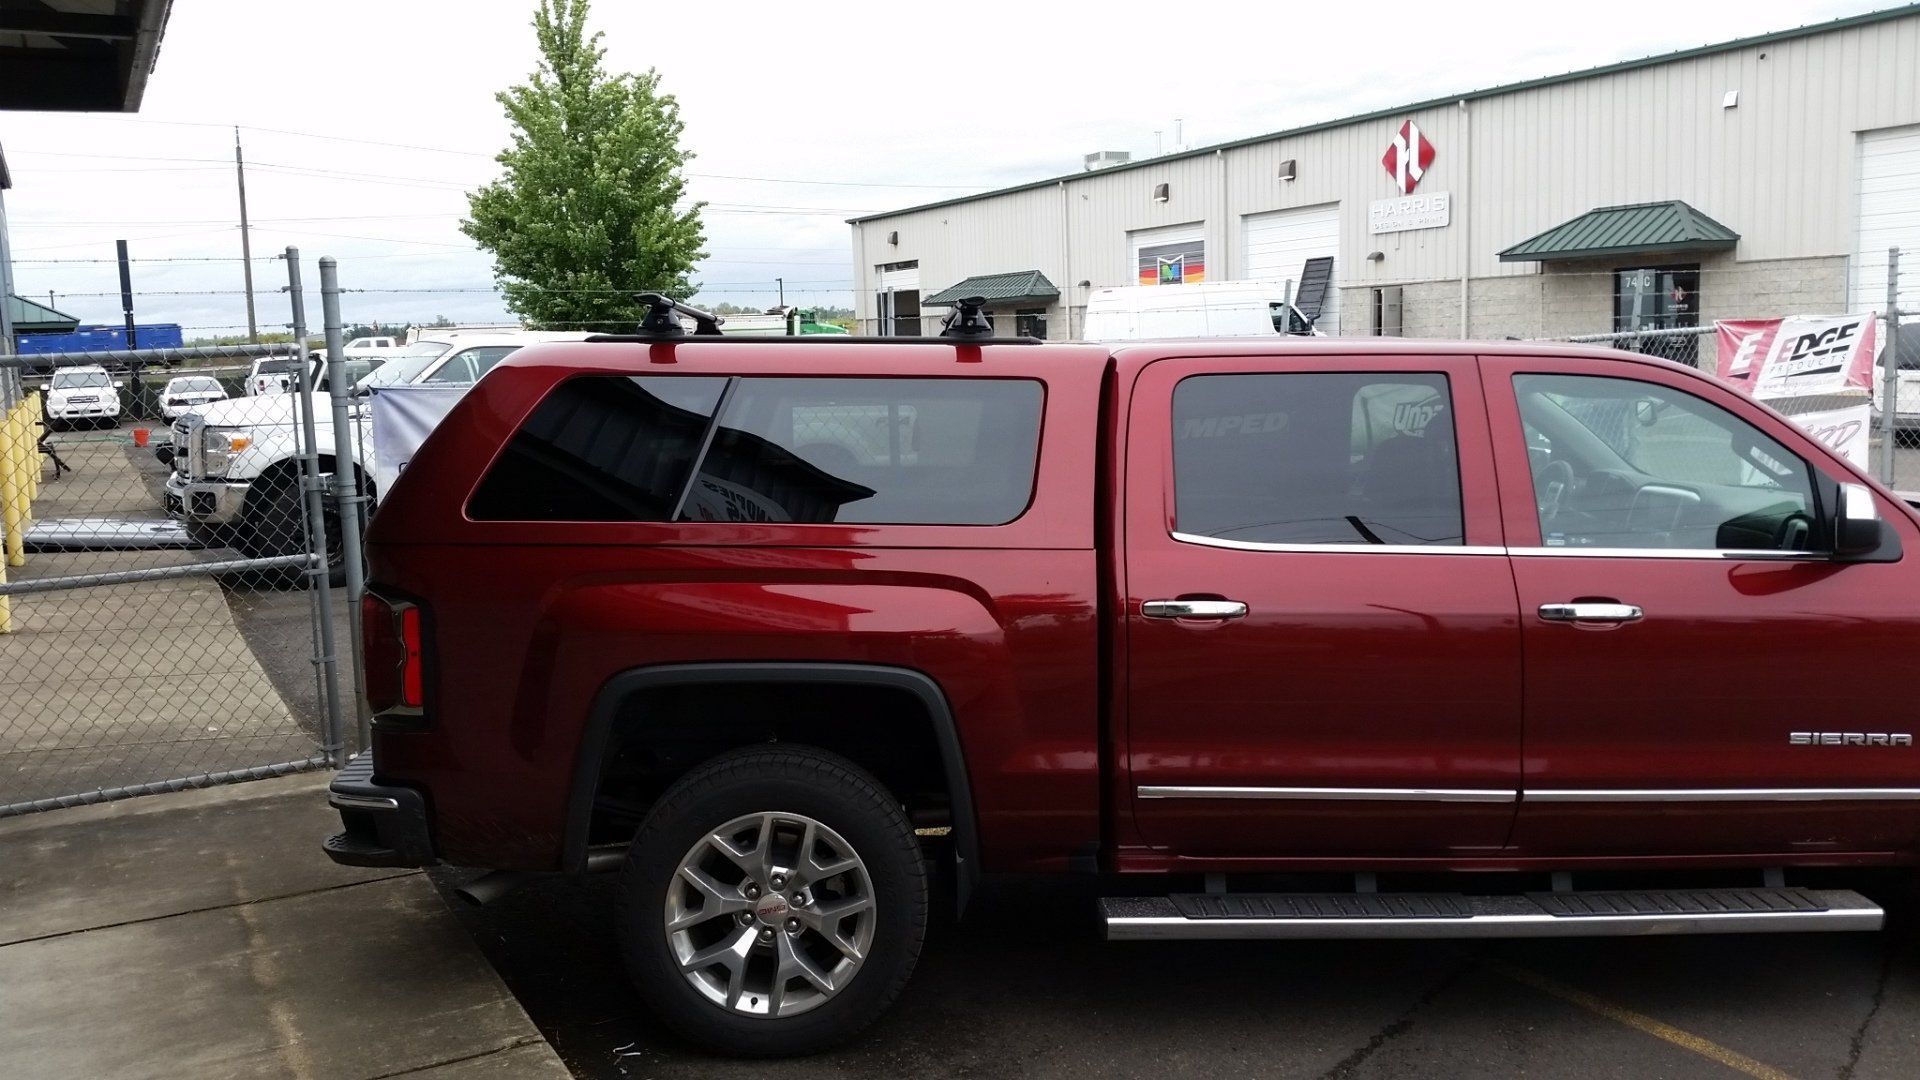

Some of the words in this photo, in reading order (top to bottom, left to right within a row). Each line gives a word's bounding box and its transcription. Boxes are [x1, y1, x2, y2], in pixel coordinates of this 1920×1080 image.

[1371, 196, 1446, 218] HARRIS
[1774, 321, 1860, 364] EDGE
[1769, 353, 1847, 373] PRODUCTS
[1789, 732, 1913, 746] SIERRA
